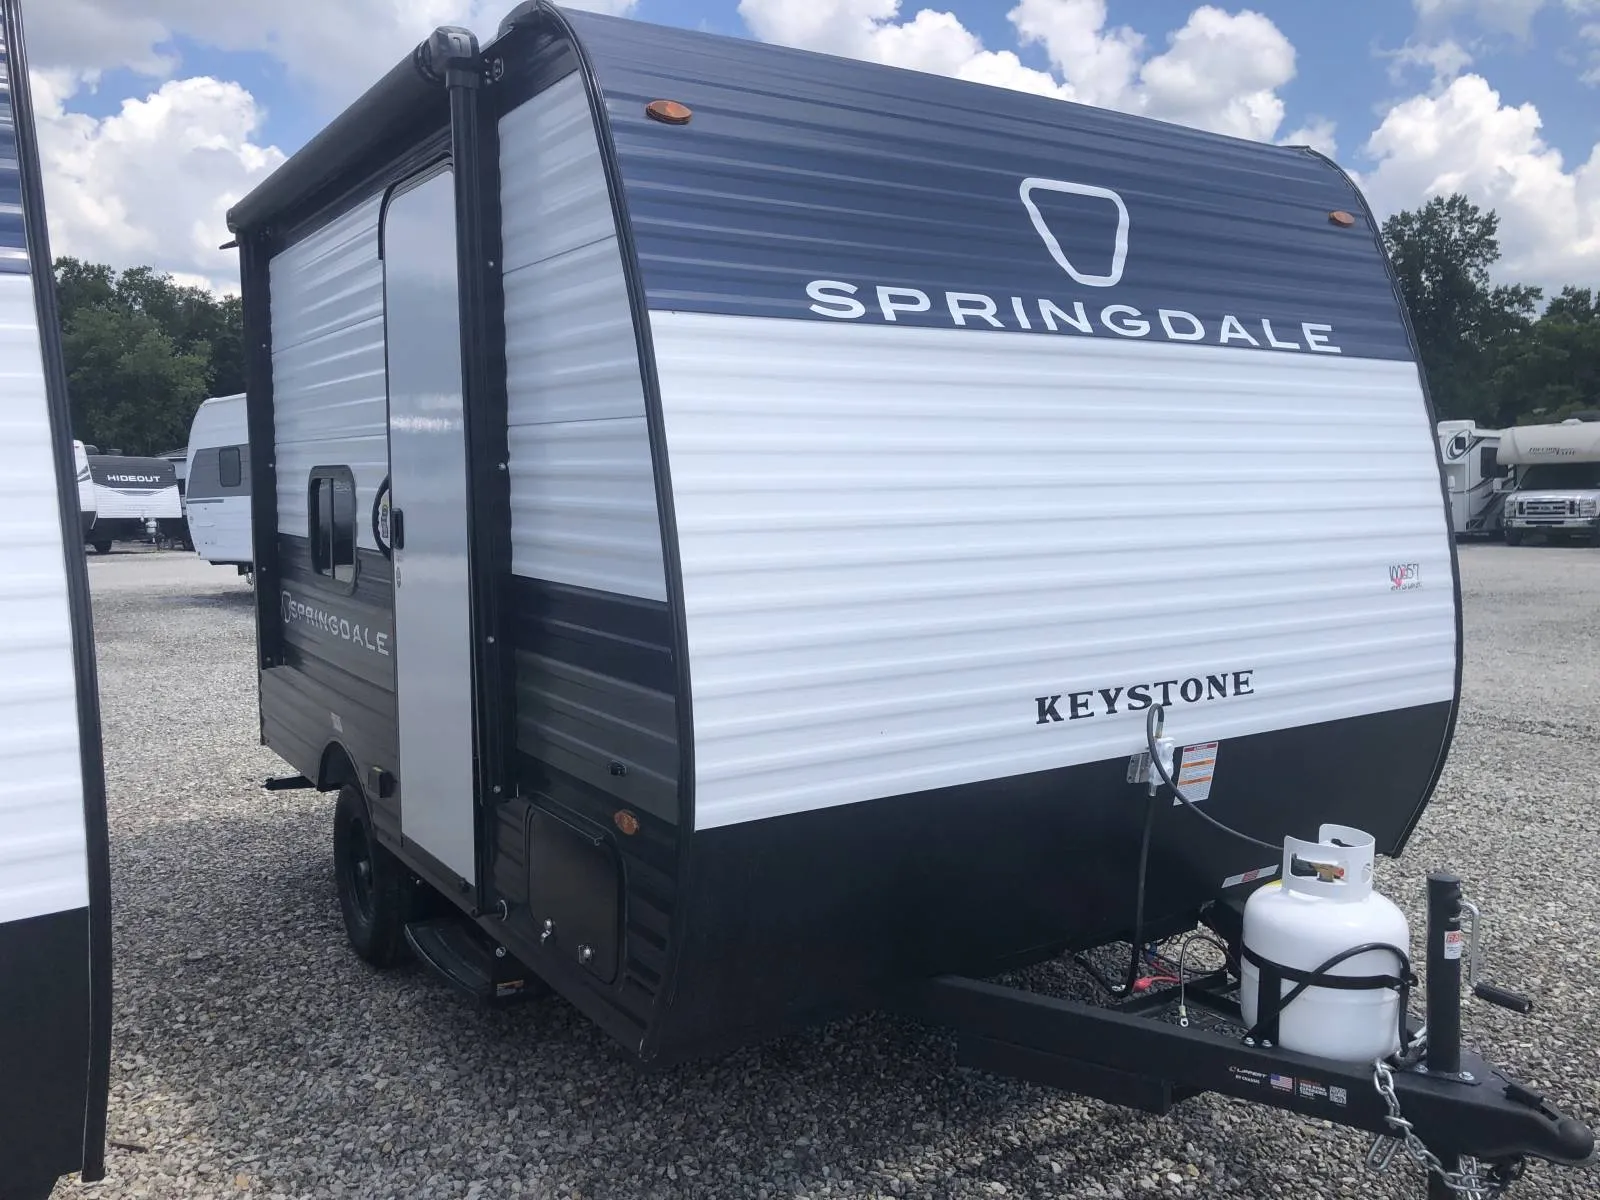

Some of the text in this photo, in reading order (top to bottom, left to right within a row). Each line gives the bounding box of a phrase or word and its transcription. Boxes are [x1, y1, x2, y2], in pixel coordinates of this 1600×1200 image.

[806, 279, 1342, 354] SPRINGDALE
[106, 474, 161, 483] HIDEOUT
[290, 600, 389, 656] SPRINGDALE
[1035, 670, 1255, 724] KEYSTONE
